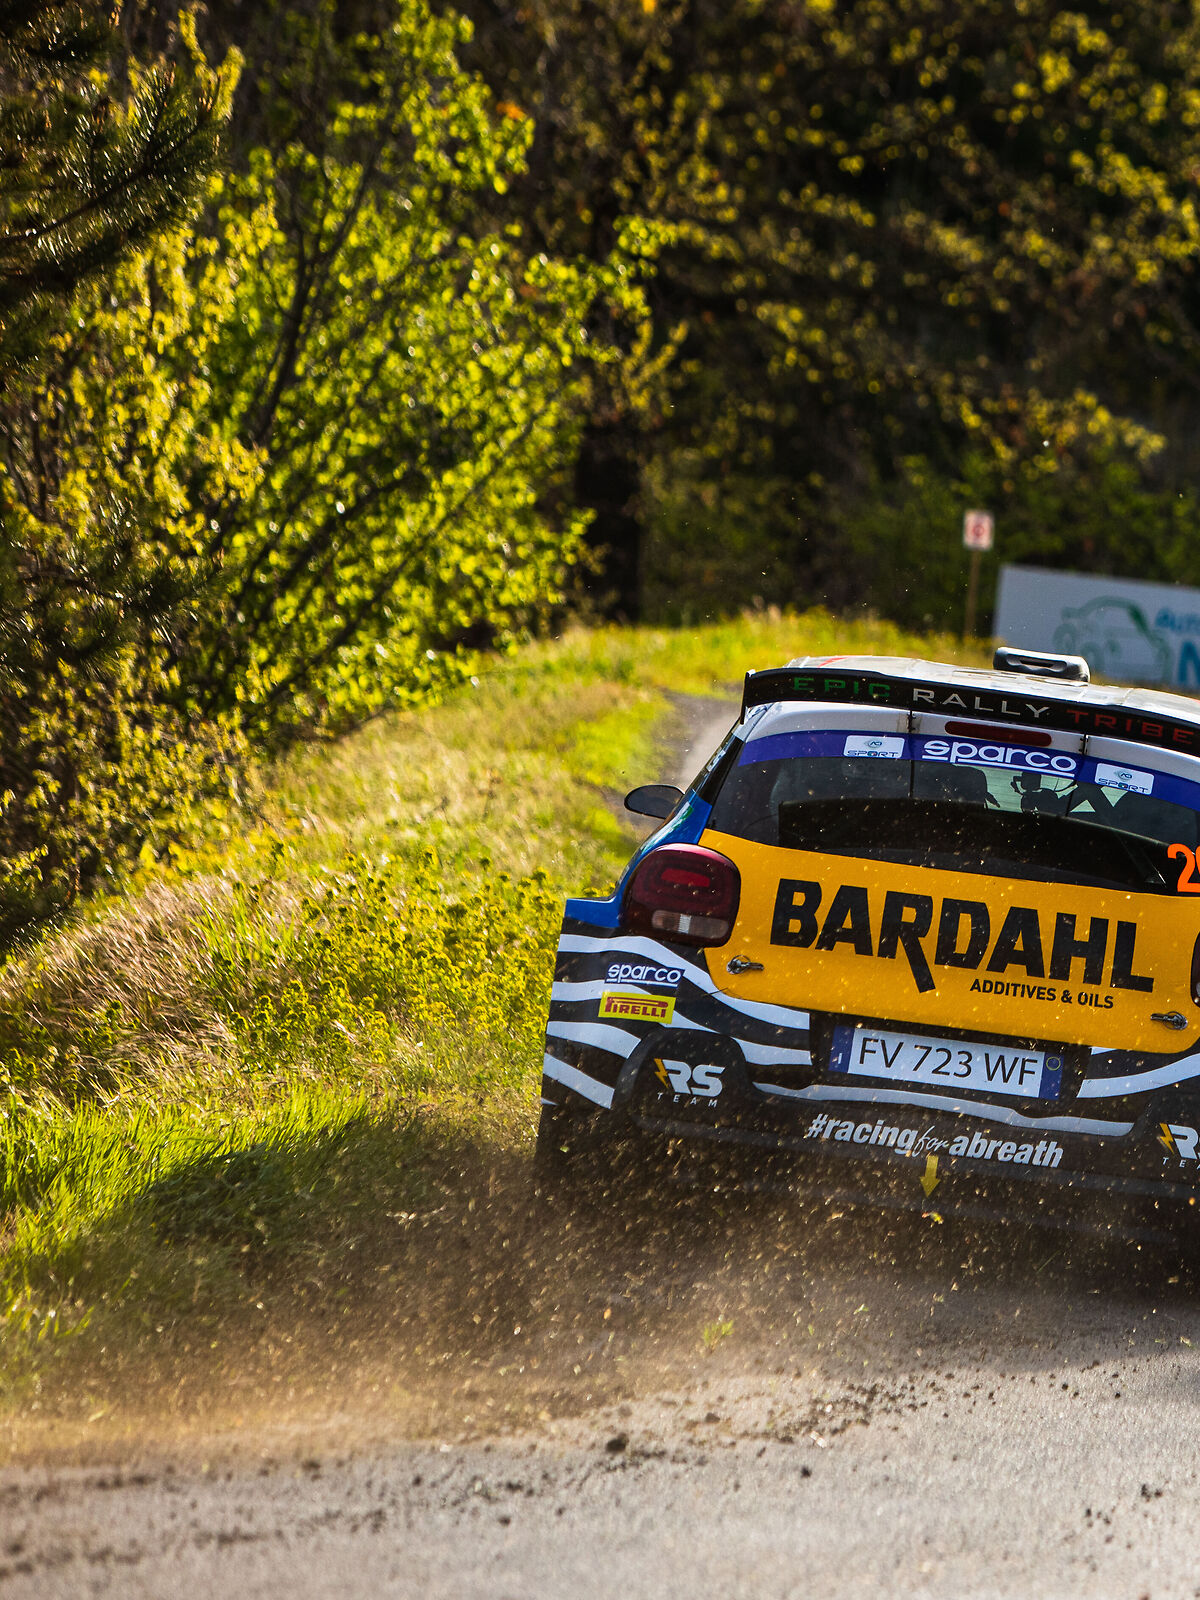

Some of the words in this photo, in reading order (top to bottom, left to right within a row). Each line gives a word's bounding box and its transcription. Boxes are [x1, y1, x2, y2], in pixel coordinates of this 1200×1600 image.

[793, 677, 890, 698] EPIC
[912, 688, 1052, 718] RALLY
[1066, 709, 1195, 745] TRIBE
[847, 749, 899, 758] SPORT
[923, 740, 1077, 772] sparco
[1098, 777, 1149, 793] SPORT
[770, 878, 1154, 993] BARDAHL
[607, 963, 682, 984] sparco
[604, 996, 668, 1018] PIRELLI
[969, 978, 1057, 1003] ADDITIVES
[1060, 991, 1073, 1004] &
[1077, 992, 1114, 1009] OILS
[858, 1037, 904, 1069] FV
[912, 1044, 973, 1078] 723
[984, 1053, 1038, 1086] WF
[661, 1058, 726, 1097] RS
[656, 1092, 719, 1108] TEAM
